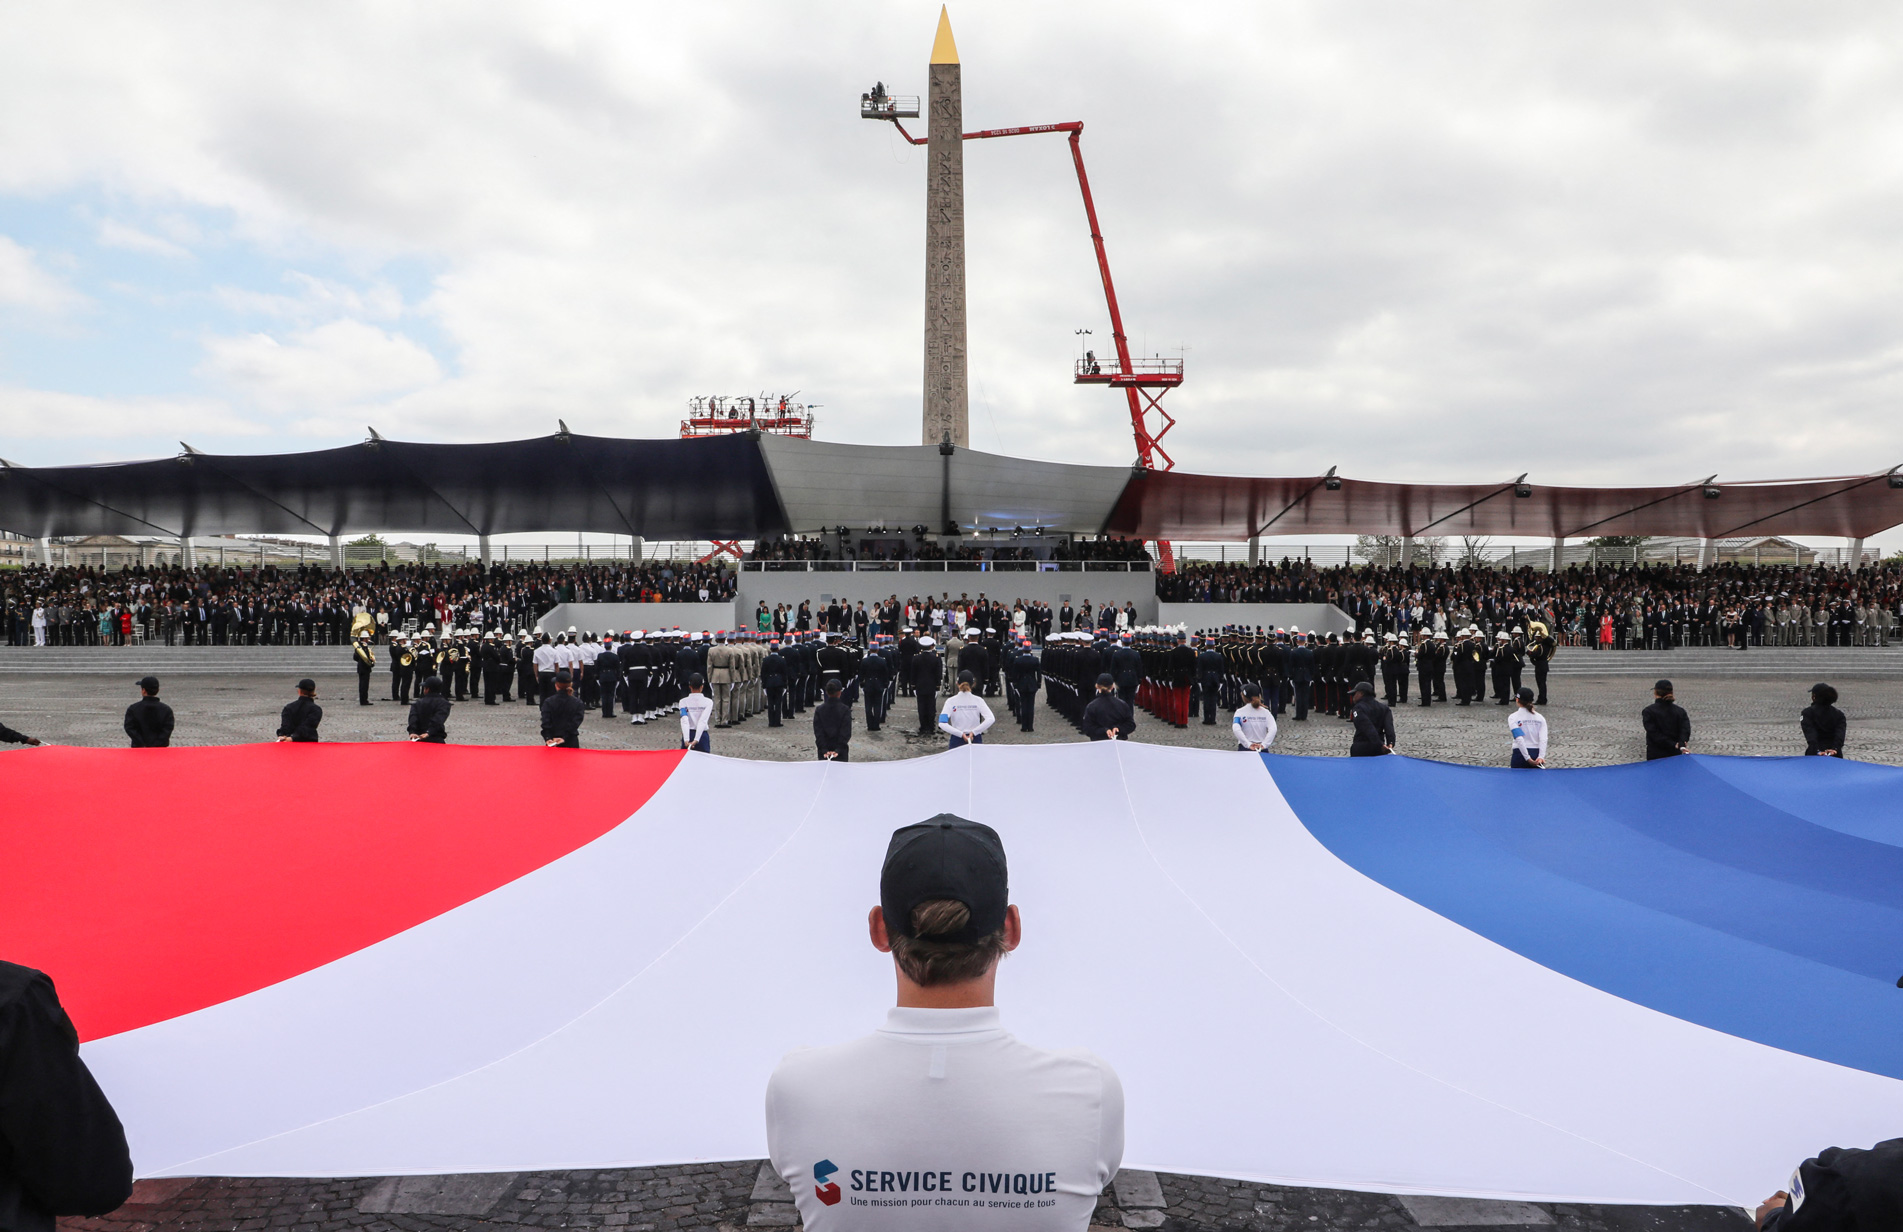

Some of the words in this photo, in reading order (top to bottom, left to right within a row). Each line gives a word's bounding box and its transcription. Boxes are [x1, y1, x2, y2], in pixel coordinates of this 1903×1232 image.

[850, 1169, 952, 1192] SERVICE
[962, 1172, 1057, 1195] CIVIQUE
[850, 1196, 868, 1206] Une
[871, 1197, 908, 1207] mission
[911, 1198, 932, 1208] pour
[934, 1197, 970, 1206] chacun
[972, 1199, 985, 1207] au
[988, 1199, 1021, 1209] service
[1023, 1199, 1035, 1208] de
[1037, 1199, 1056, 1208] tous
